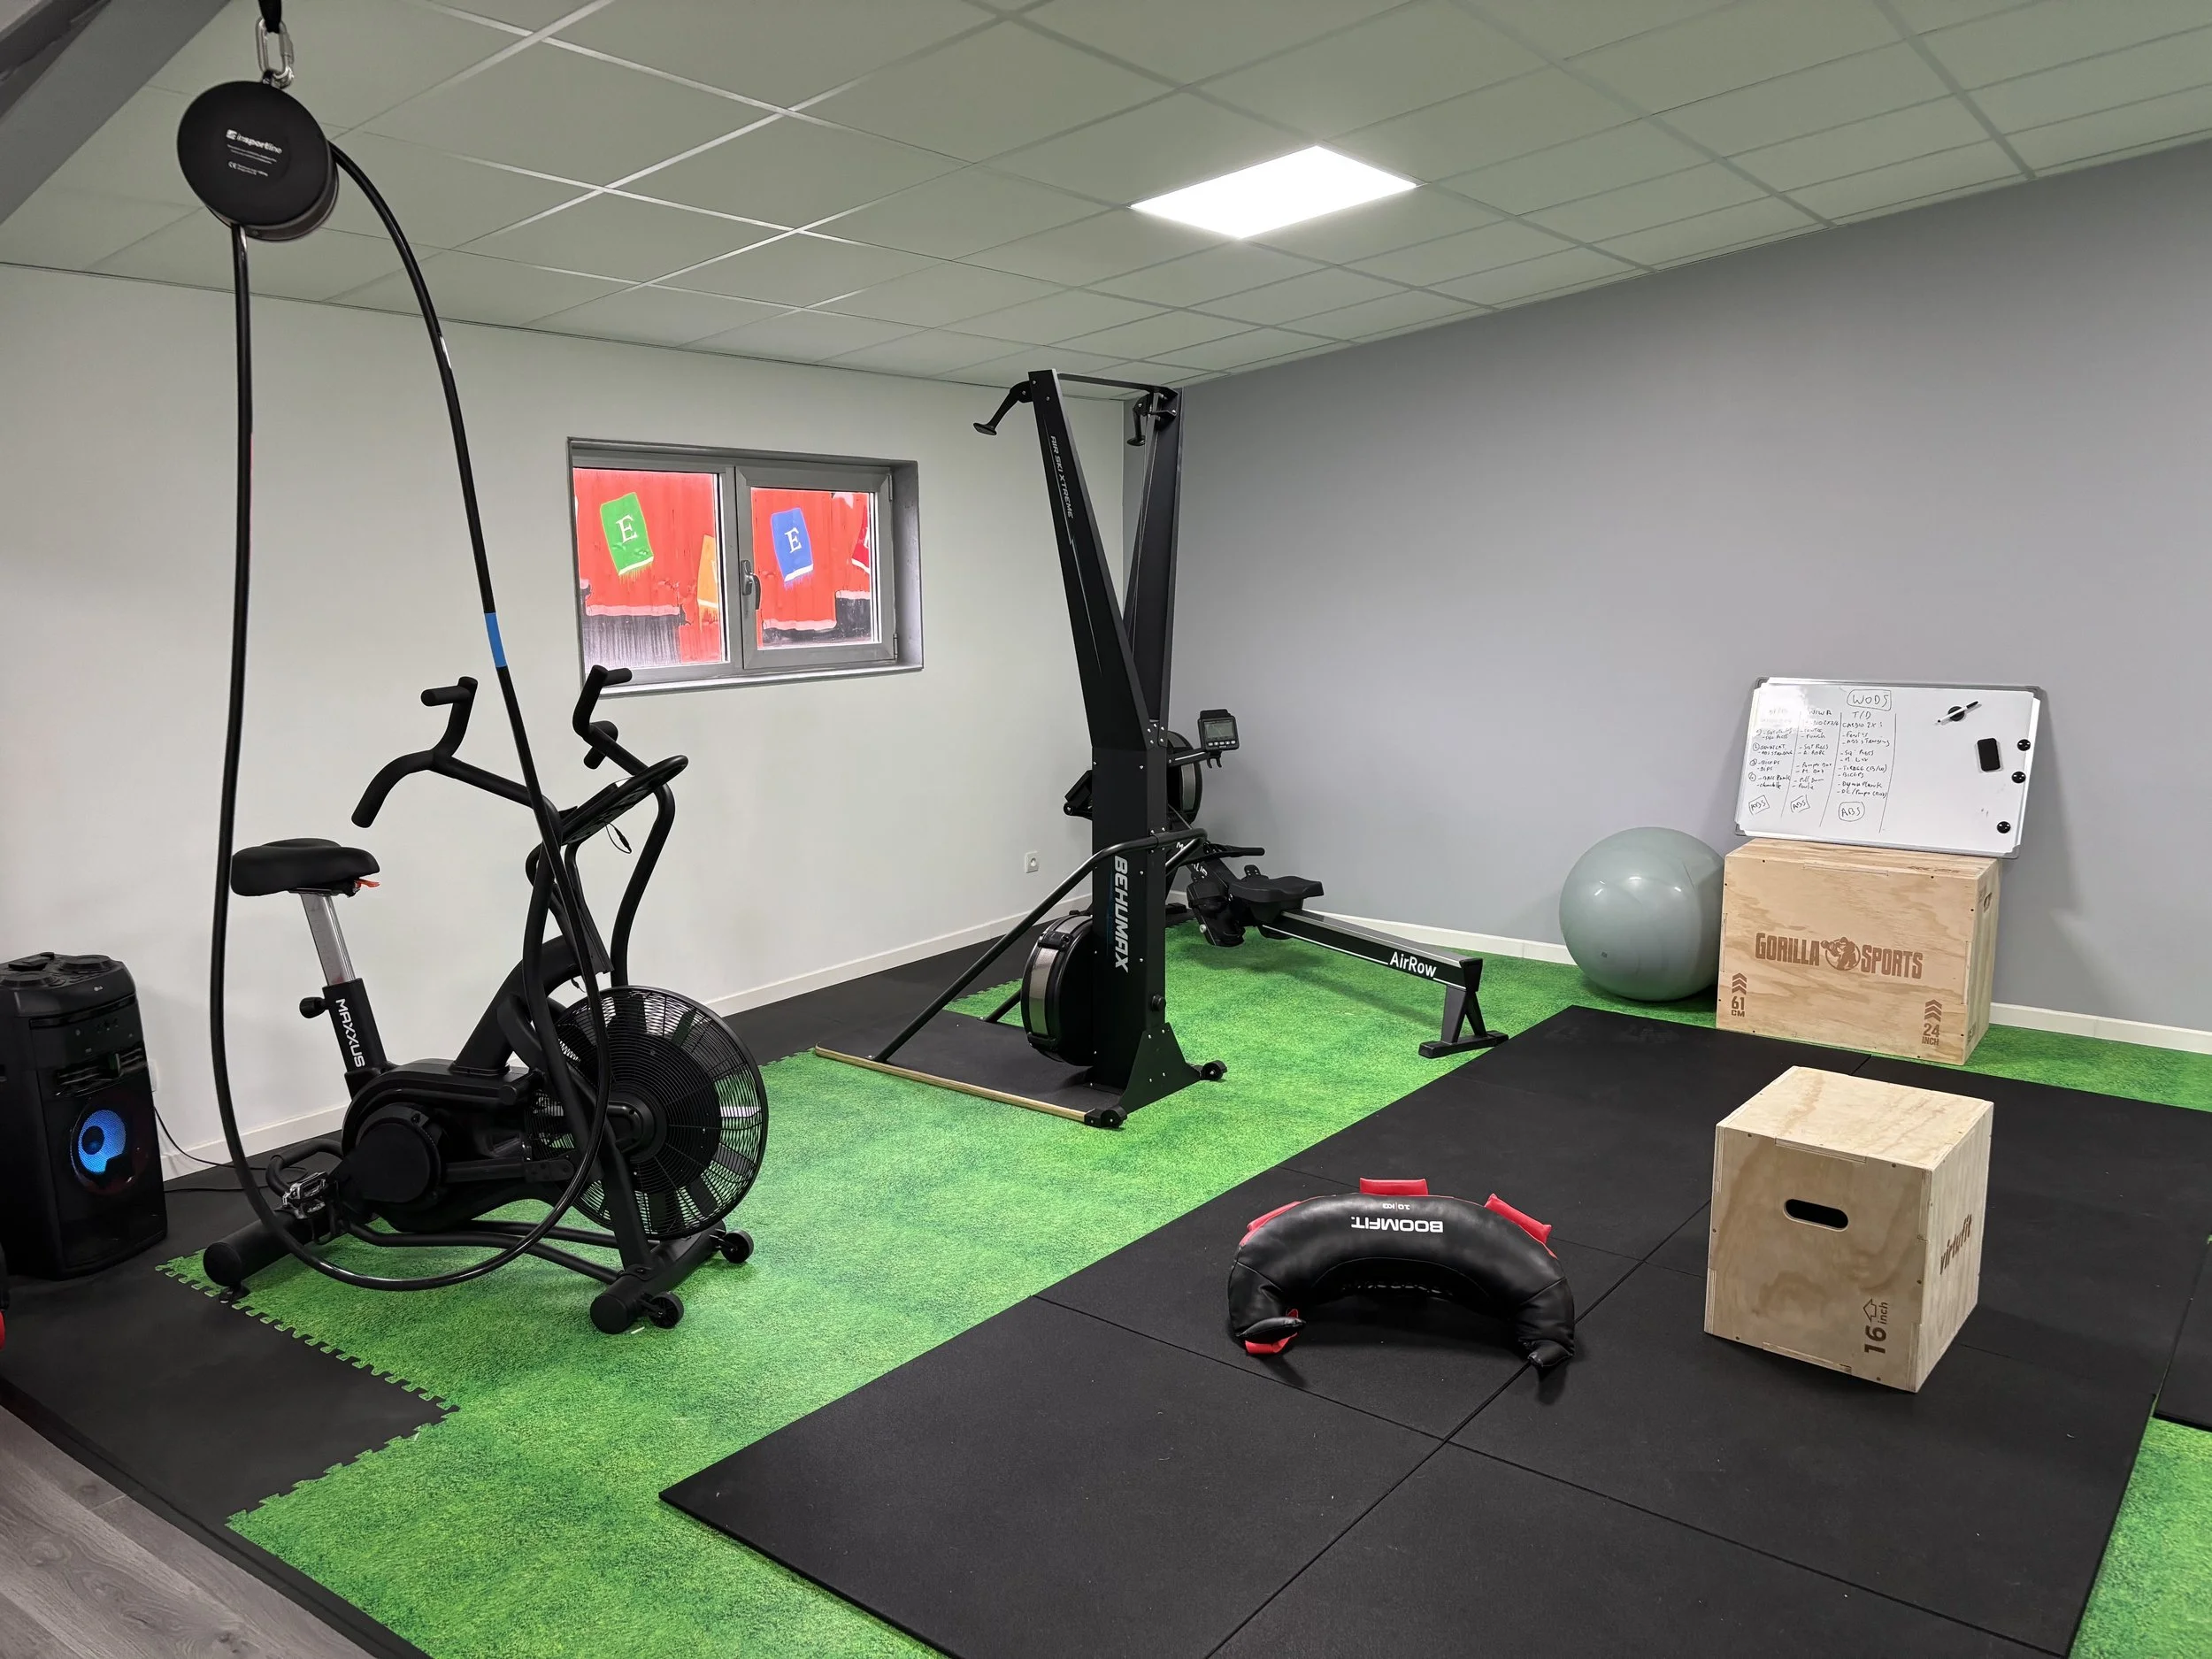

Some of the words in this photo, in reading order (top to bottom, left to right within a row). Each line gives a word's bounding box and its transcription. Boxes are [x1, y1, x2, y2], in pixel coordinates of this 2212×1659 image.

[1050, 435, 1059, 454] AIR
[1055, 455, 1064, 472] SKI
[1058, 473, 1074, 519] XTREME
[615, 514, 638, 543] E
[784, 527, 803, 554] E
[1852, 695, 1889, 708] WODS
[1840, 807, 1861, 818] ABS
[1115, 856, 1128, 973] BEHUMAX
[1389, 951, 1438, 978] AirRow
[1755, 932, 1821, 966] GORILLA
[1861, 944, 1924, 979] SPORTS
[1731, 995, 1745, 1010] 61
[335, 998, 365, 1068] MAXXUS
[1922, 1036, 1939, 1047] INCH
[1923, 1023, 1940, 1038] 24
[1939, 1213, 1972, 1275] virtufit
[1877, 1302, 1889, 1325] inch
[1863, 1325, 1887, 1355] 16
